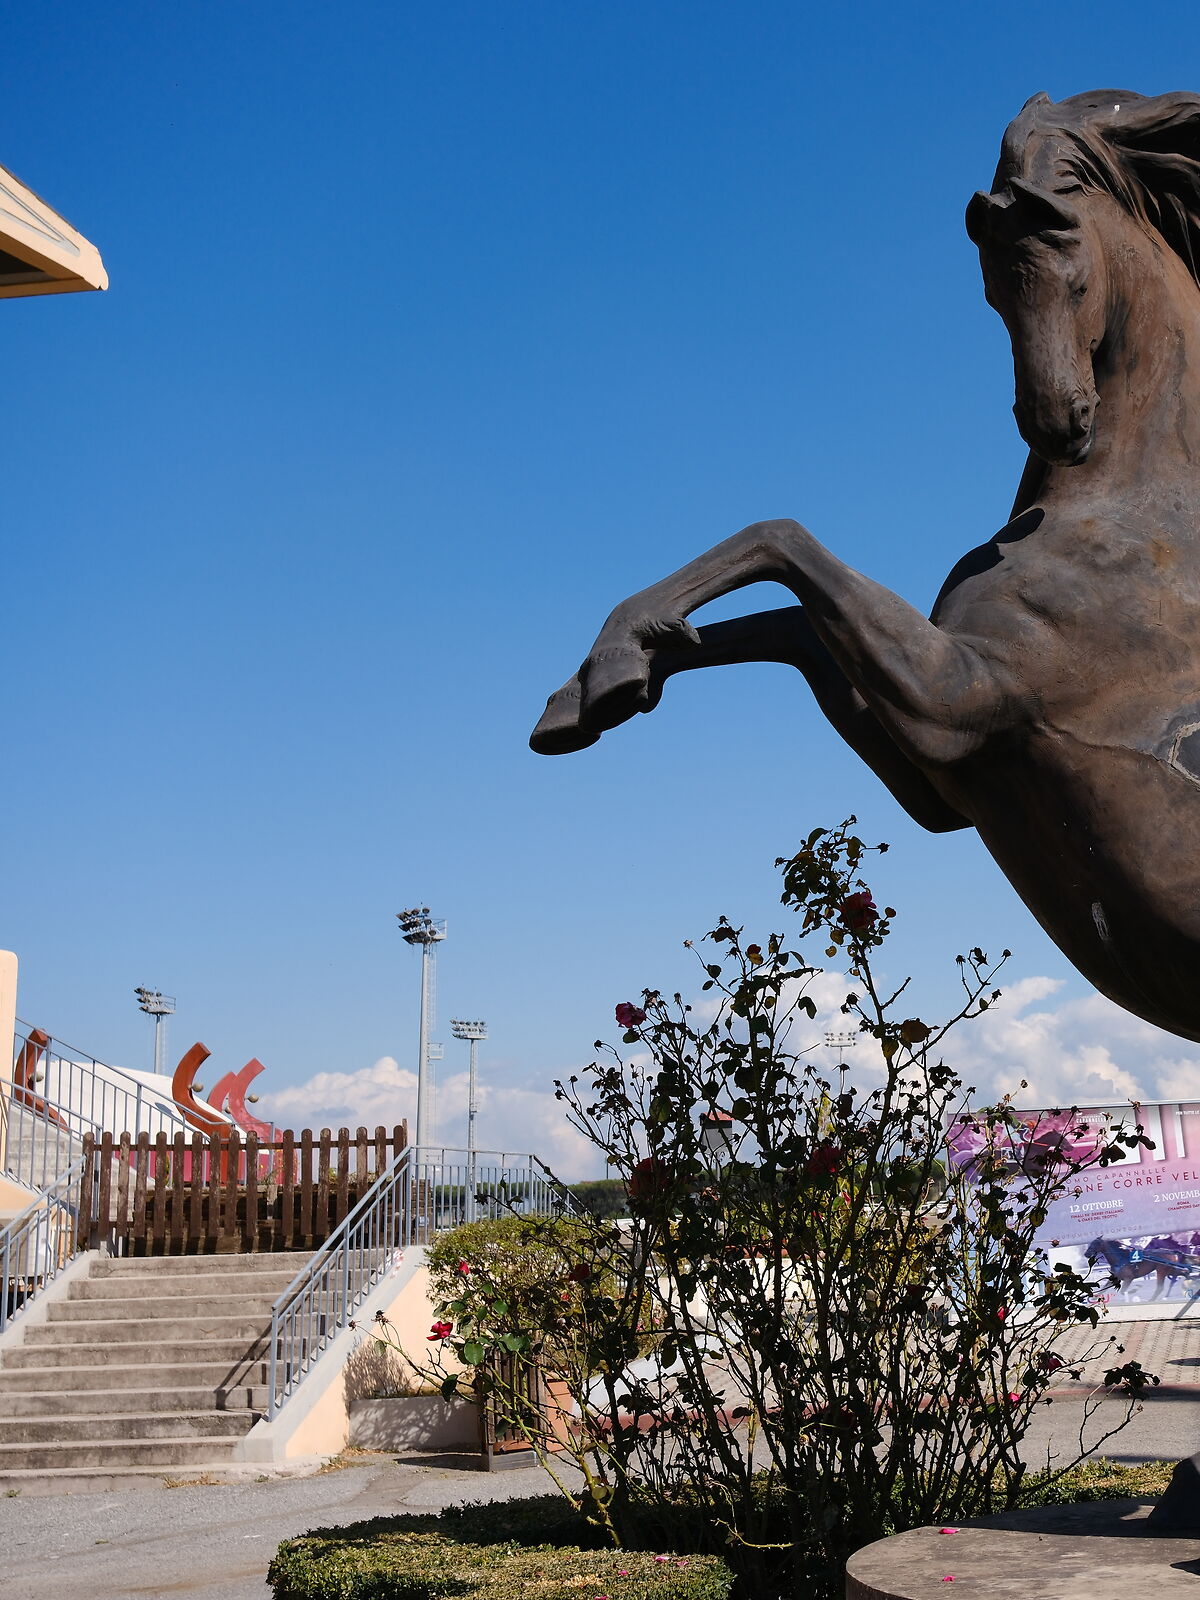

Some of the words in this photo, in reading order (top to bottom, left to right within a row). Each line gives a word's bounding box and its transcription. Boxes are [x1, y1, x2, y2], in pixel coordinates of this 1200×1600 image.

[1096, 1166, 1166, 1180] CAPANNELLE
[1113, 1175, 1162, 1189] CORRE
[1153, 1194, 1160, 1203] 2
[1069, 1204, 1081, 1213] 12
[1082, 1199, 1124, 1212] OTTOBRE
[1131, 1250, 1140, 1260] 4
